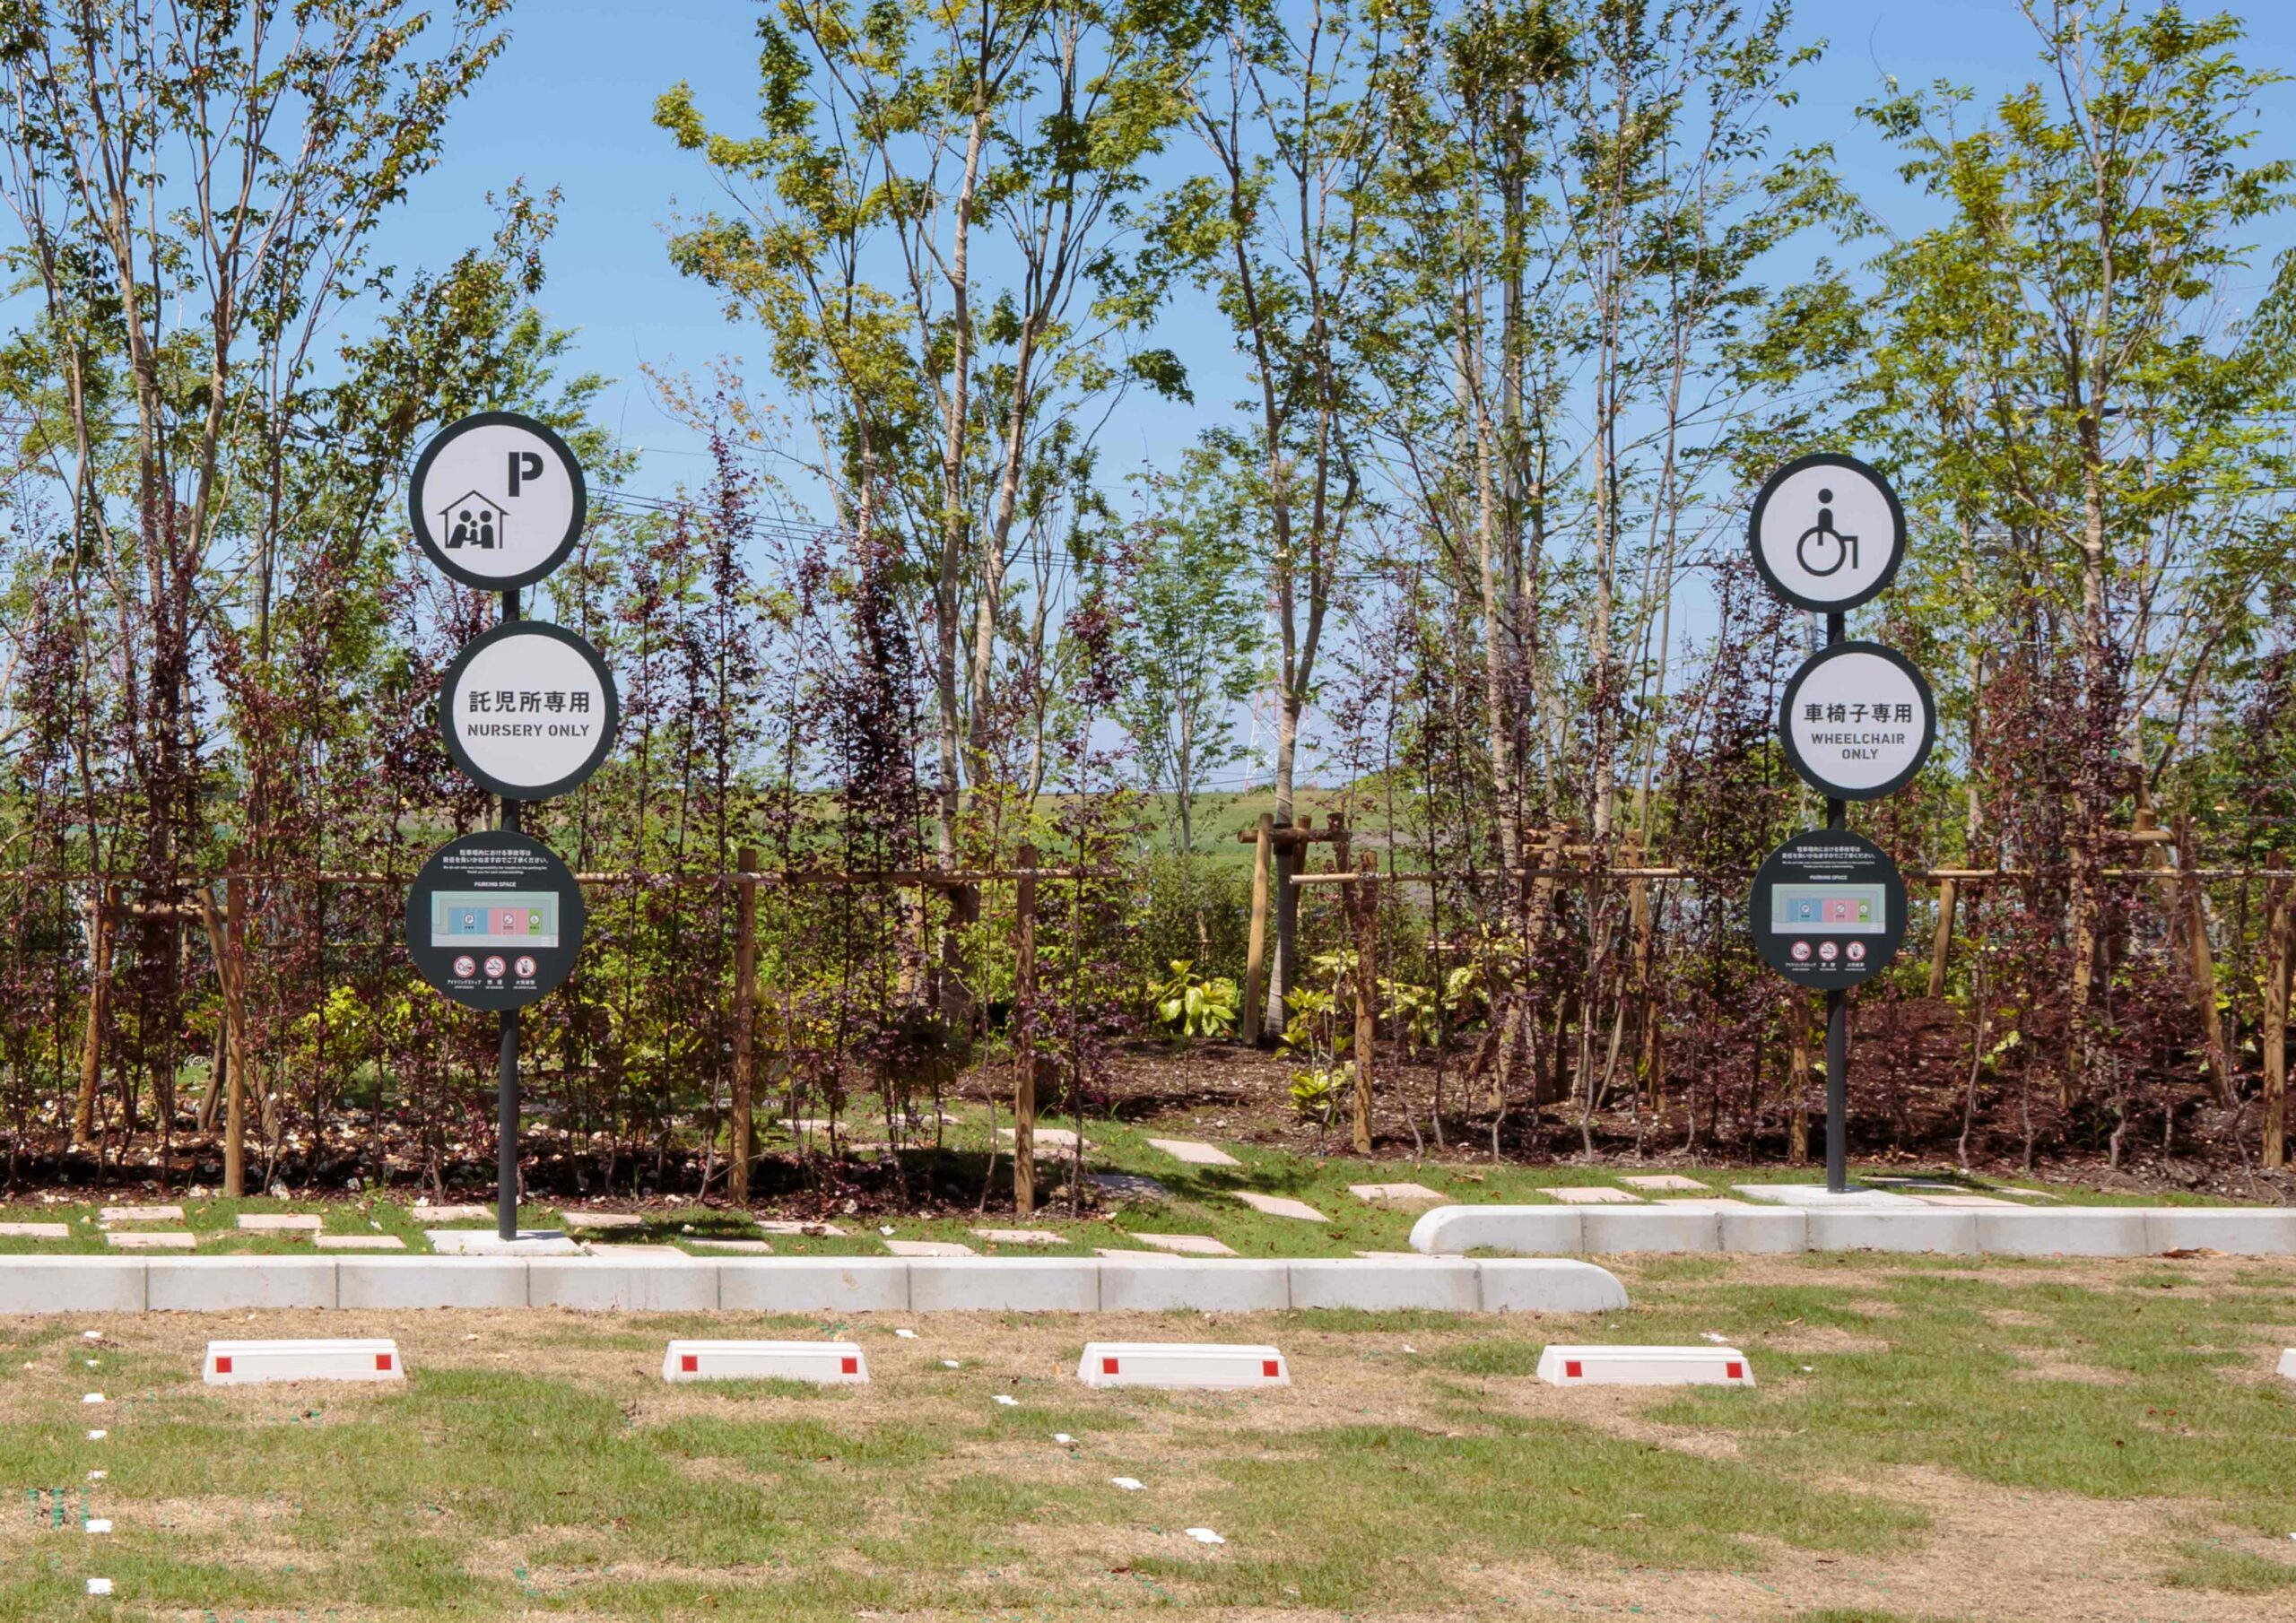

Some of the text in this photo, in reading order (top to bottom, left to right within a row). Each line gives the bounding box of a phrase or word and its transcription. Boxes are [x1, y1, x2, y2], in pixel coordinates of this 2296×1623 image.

[508, 451, 544, 498] P
[468, 690, 590, 714] 託児所専用
[1803, 702, 1912, 724] 車椅子専用
[467, 724, 590, 737] NURSERY ONLY
[1811, 733, 1906, 745] WHEELCHAIR
[1841, 748, 1878, 760] ONLY
